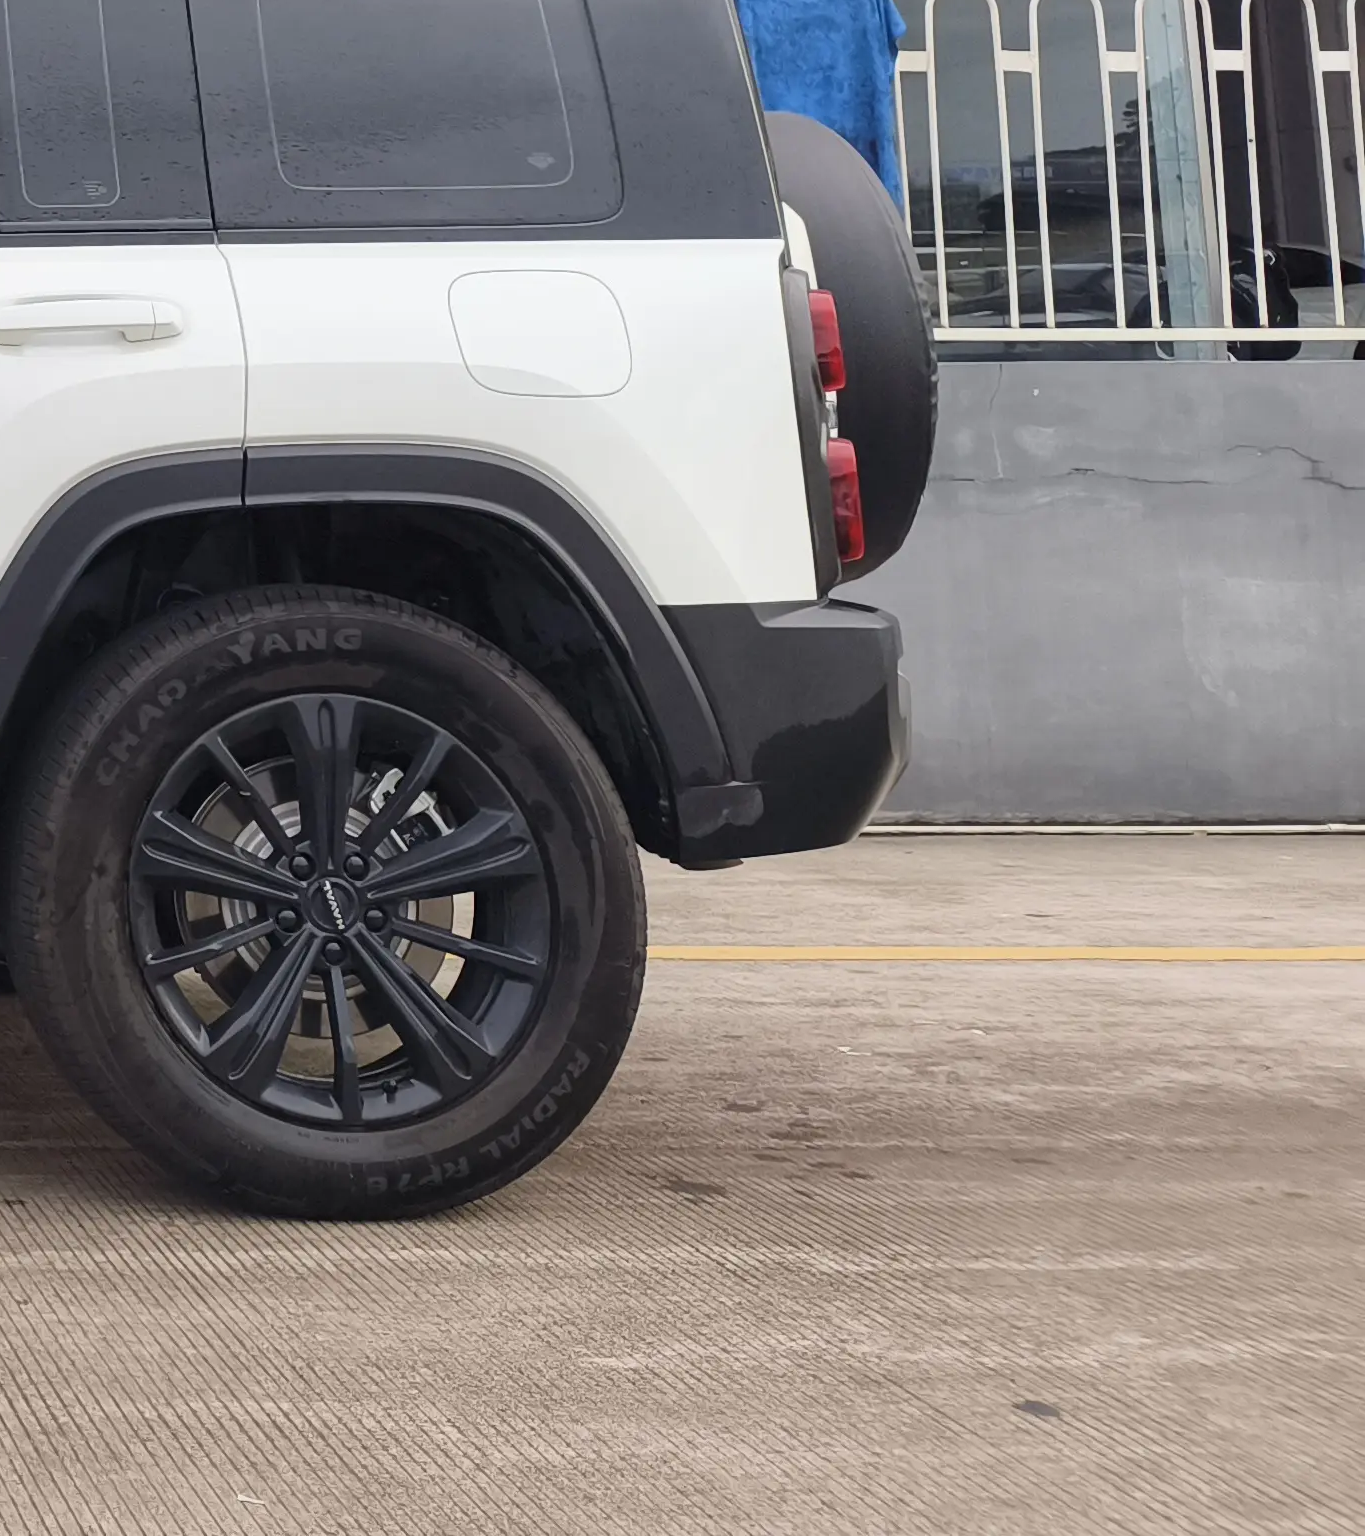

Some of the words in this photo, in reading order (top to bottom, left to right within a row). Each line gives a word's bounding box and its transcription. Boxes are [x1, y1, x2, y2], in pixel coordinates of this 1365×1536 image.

[226, 627, 363, 665] YANG
[323, 880, 346, 930] HAVAL
[478, 1048, 592, 1161] RADIAL
